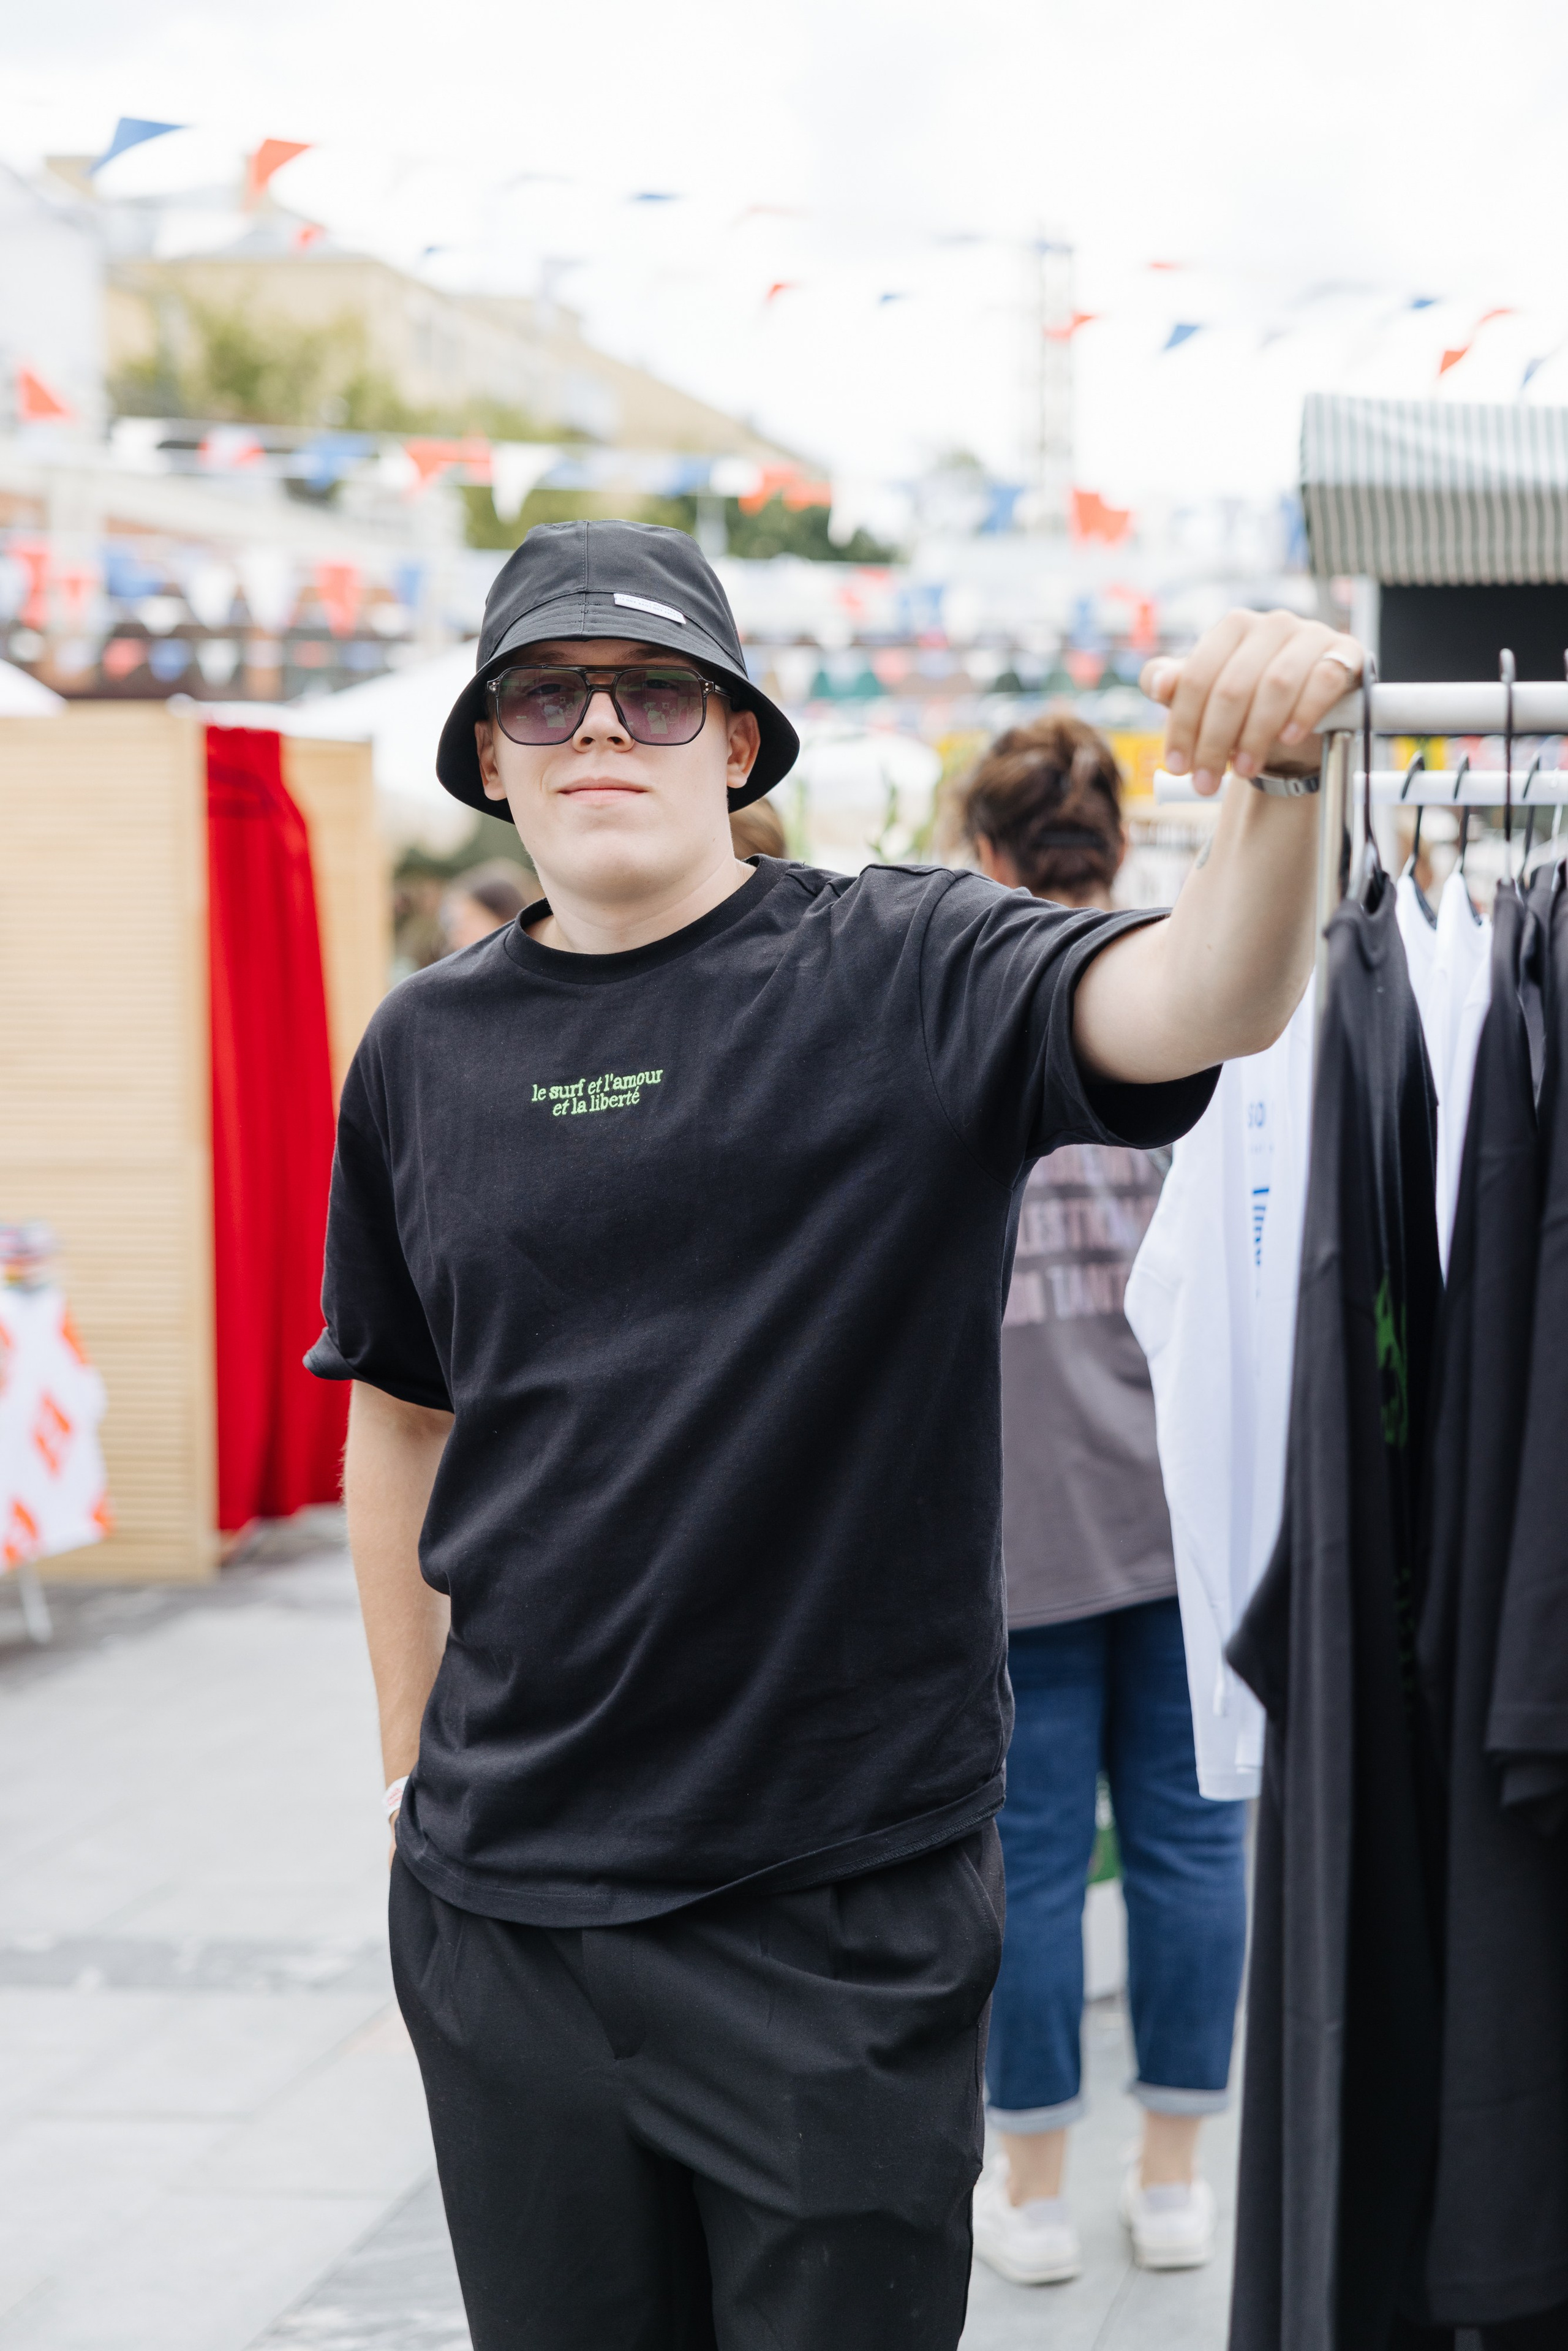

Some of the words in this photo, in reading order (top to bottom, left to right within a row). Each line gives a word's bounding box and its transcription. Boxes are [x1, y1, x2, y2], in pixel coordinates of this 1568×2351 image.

[532, 1084, 546, 1101] le
[549, 1078, 586, 1100] surf
[587, 1077, 602, 1095] et
[603, 1070, 663, 1092] l'amour
[552, 1099, 570, 1116] et
[571, 1097, 587, 1114] la
[589, 1085, 640, 1112] liberté
